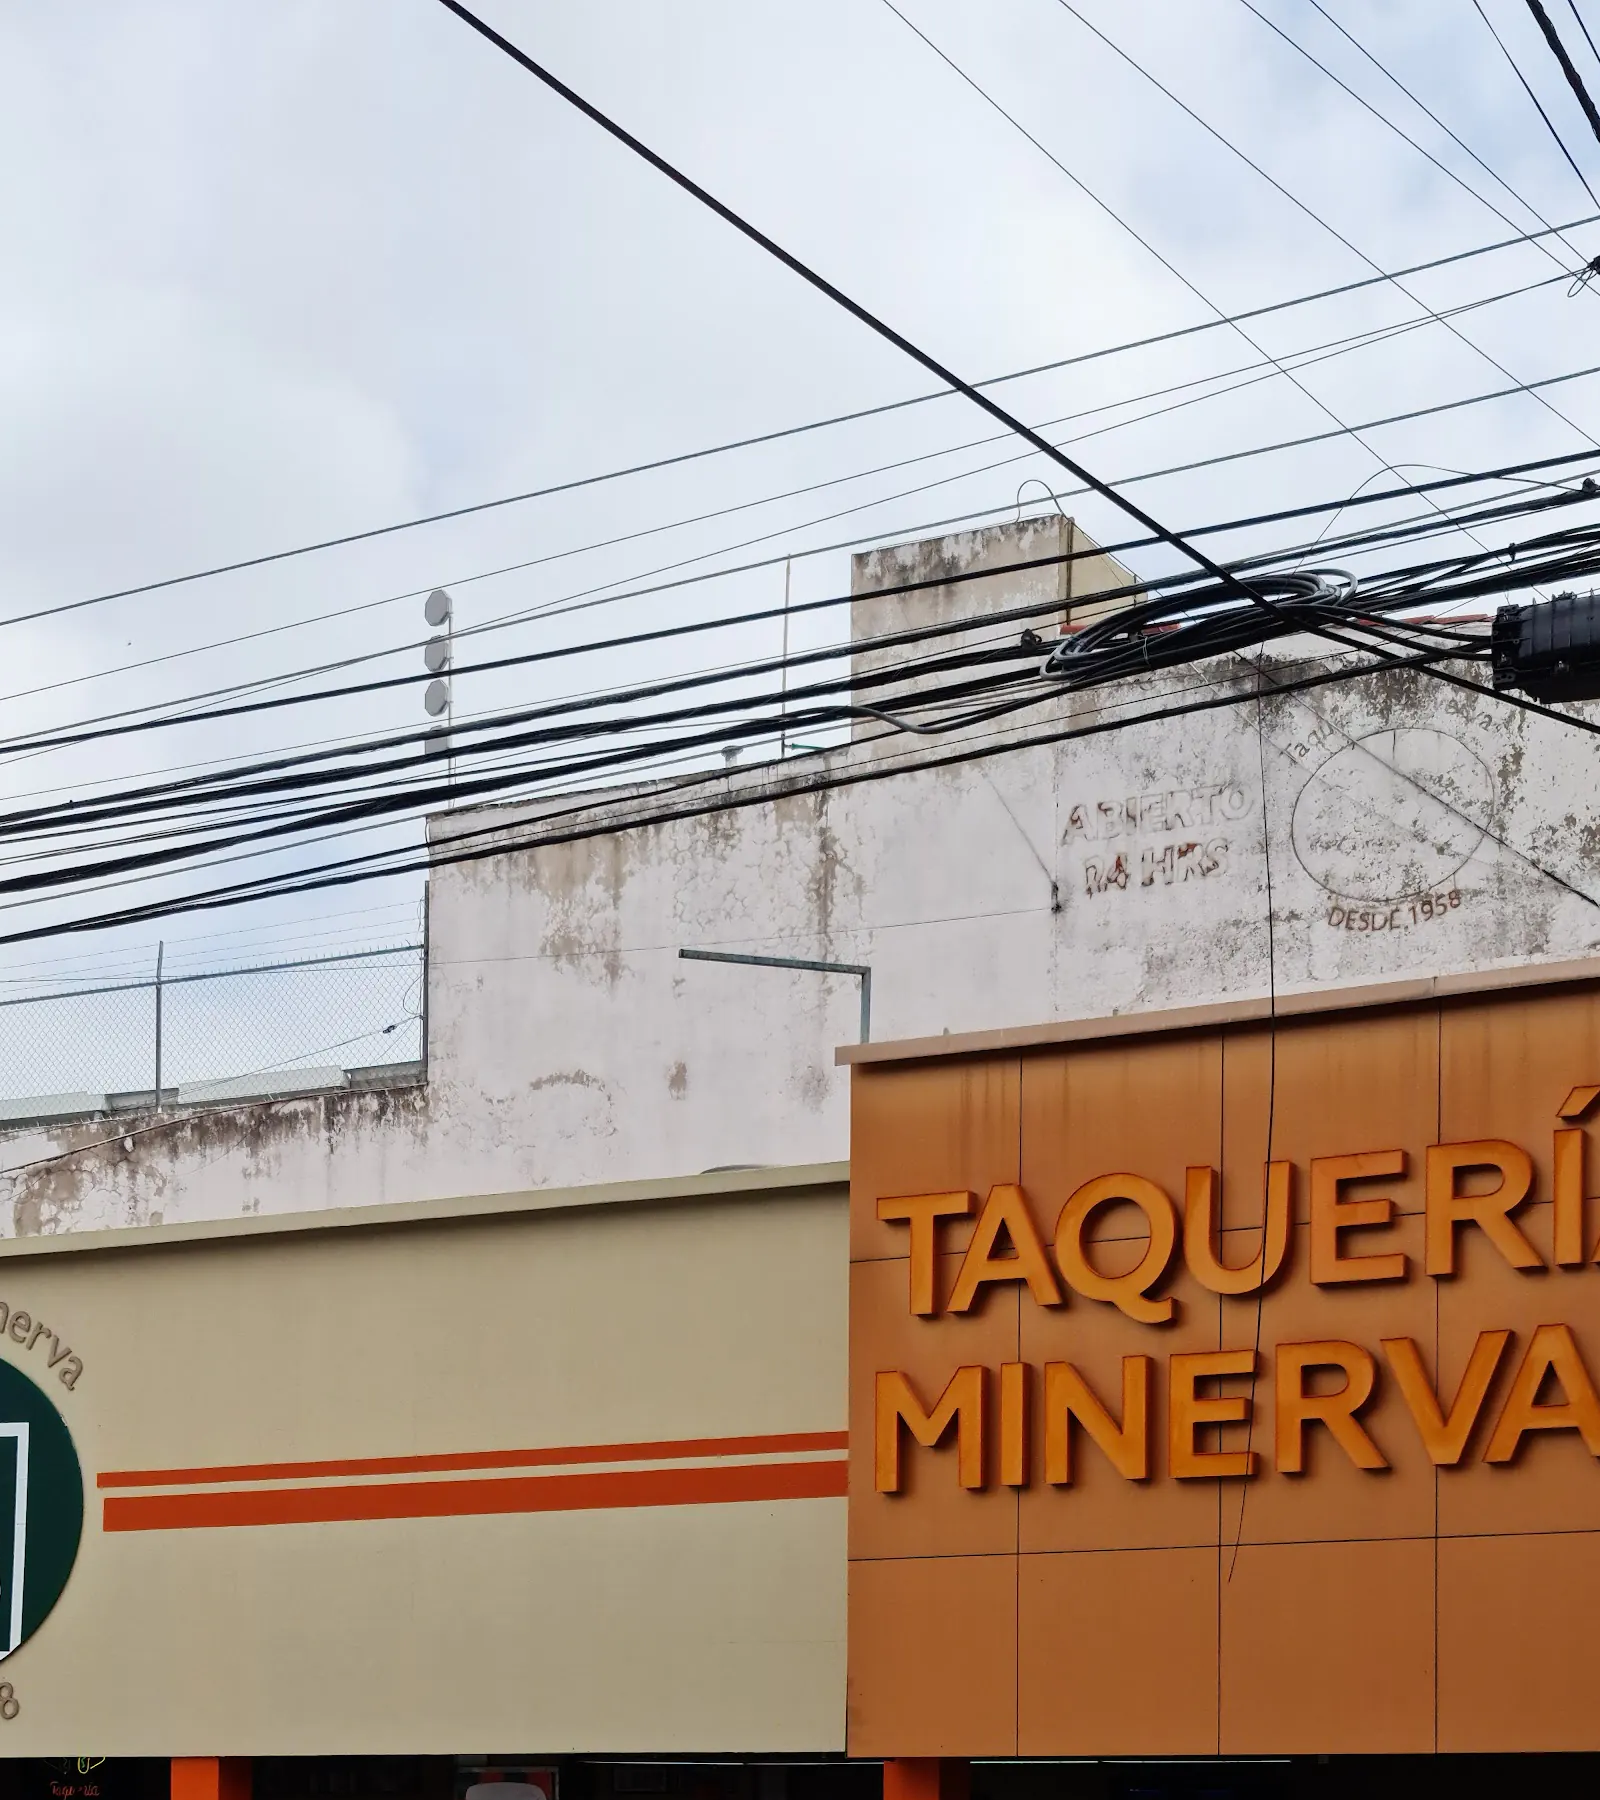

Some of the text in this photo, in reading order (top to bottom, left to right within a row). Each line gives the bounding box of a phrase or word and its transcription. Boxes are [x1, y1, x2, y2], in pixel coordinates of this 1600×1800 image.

[1060, 782, 1252, 847] ABIERTO
[1141, 837, 1229, 887] HRS
[1327, 888, 1461, 932] DESDE 1958
